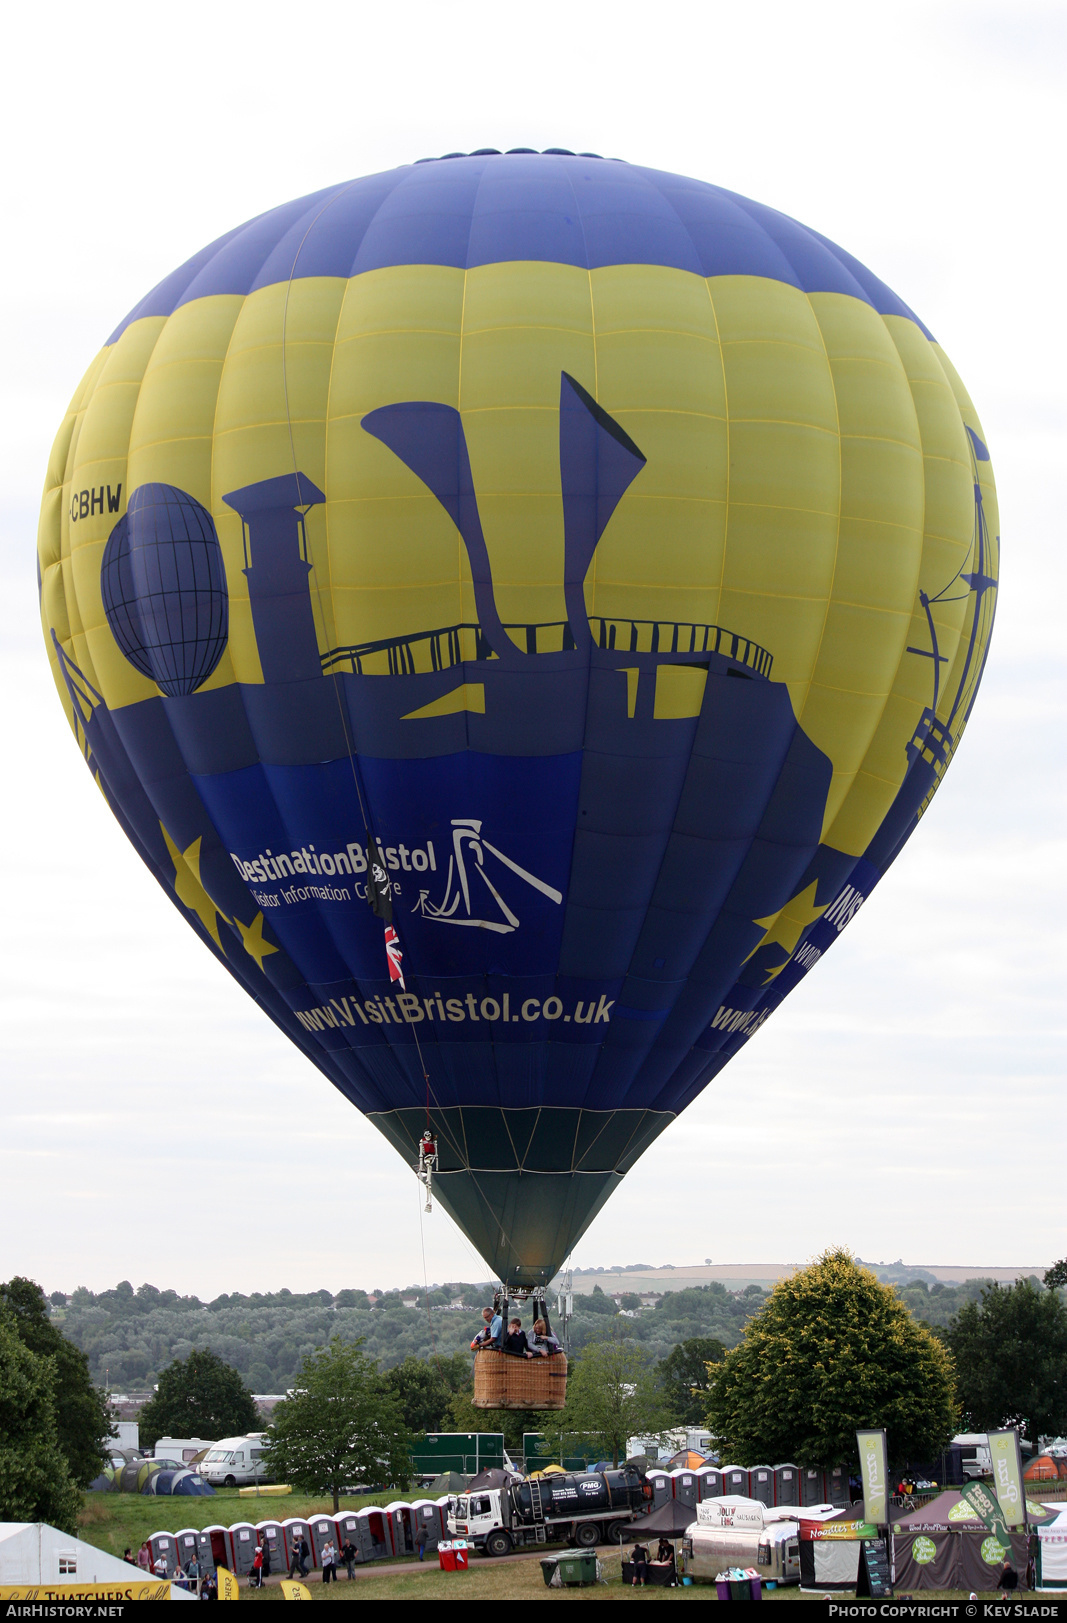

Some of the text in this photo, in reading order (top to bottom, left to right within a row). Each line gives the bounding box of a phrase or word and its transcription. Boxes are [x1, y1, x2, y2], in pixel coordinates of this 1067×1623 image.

[229, 837, 437, 883] DestinationBistol
[282, 884, 351, 905] Information
[294, 992, 616, 1032] www.VisitBristol.co.uk
[582, 1482, 599, 1490] PMG
[810, 1520, 865, 1538] Noodles etc
